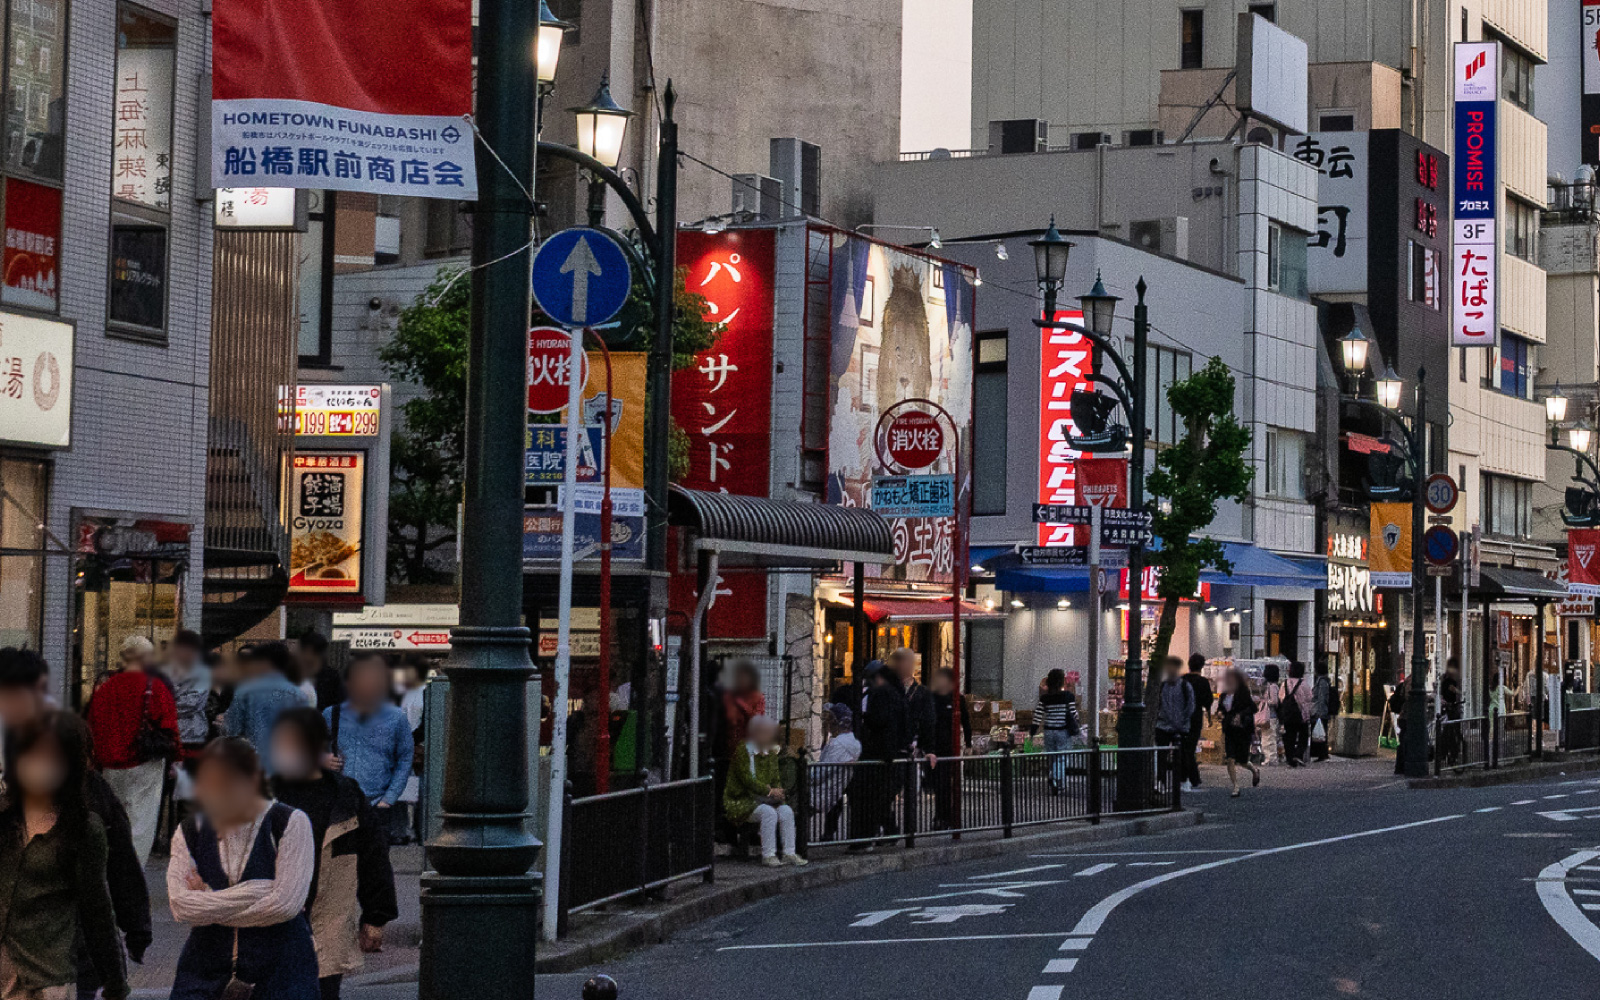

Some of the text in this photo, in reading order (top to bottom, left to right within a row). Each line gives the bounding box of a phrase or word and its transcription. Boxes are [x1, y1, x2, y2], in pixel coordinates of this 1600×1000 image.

[223, 112, 437, 141] HOMETOWN FUNABASHI
[1466, 110, 1484, 192] PROMISE
[223, 145, 465, 187] 船橋駅前商店会
[1459, 200, 1489, 211] プロミス
[1463, 224, 1486, 239] 3F
[1461, 249, 1489, 337] たばこ
[536, 338, 573, 349] HYDRANT
[303, 412, 326, 434] 199
[354, 411, 378, 435] 299
[896, 417, 934, 425] FIRE HYDRANT
[891, 428, 940, 451] 消火栓
[1430, 485, 1450, 504] 30
[293, 516, 343, 531] Gyoza
